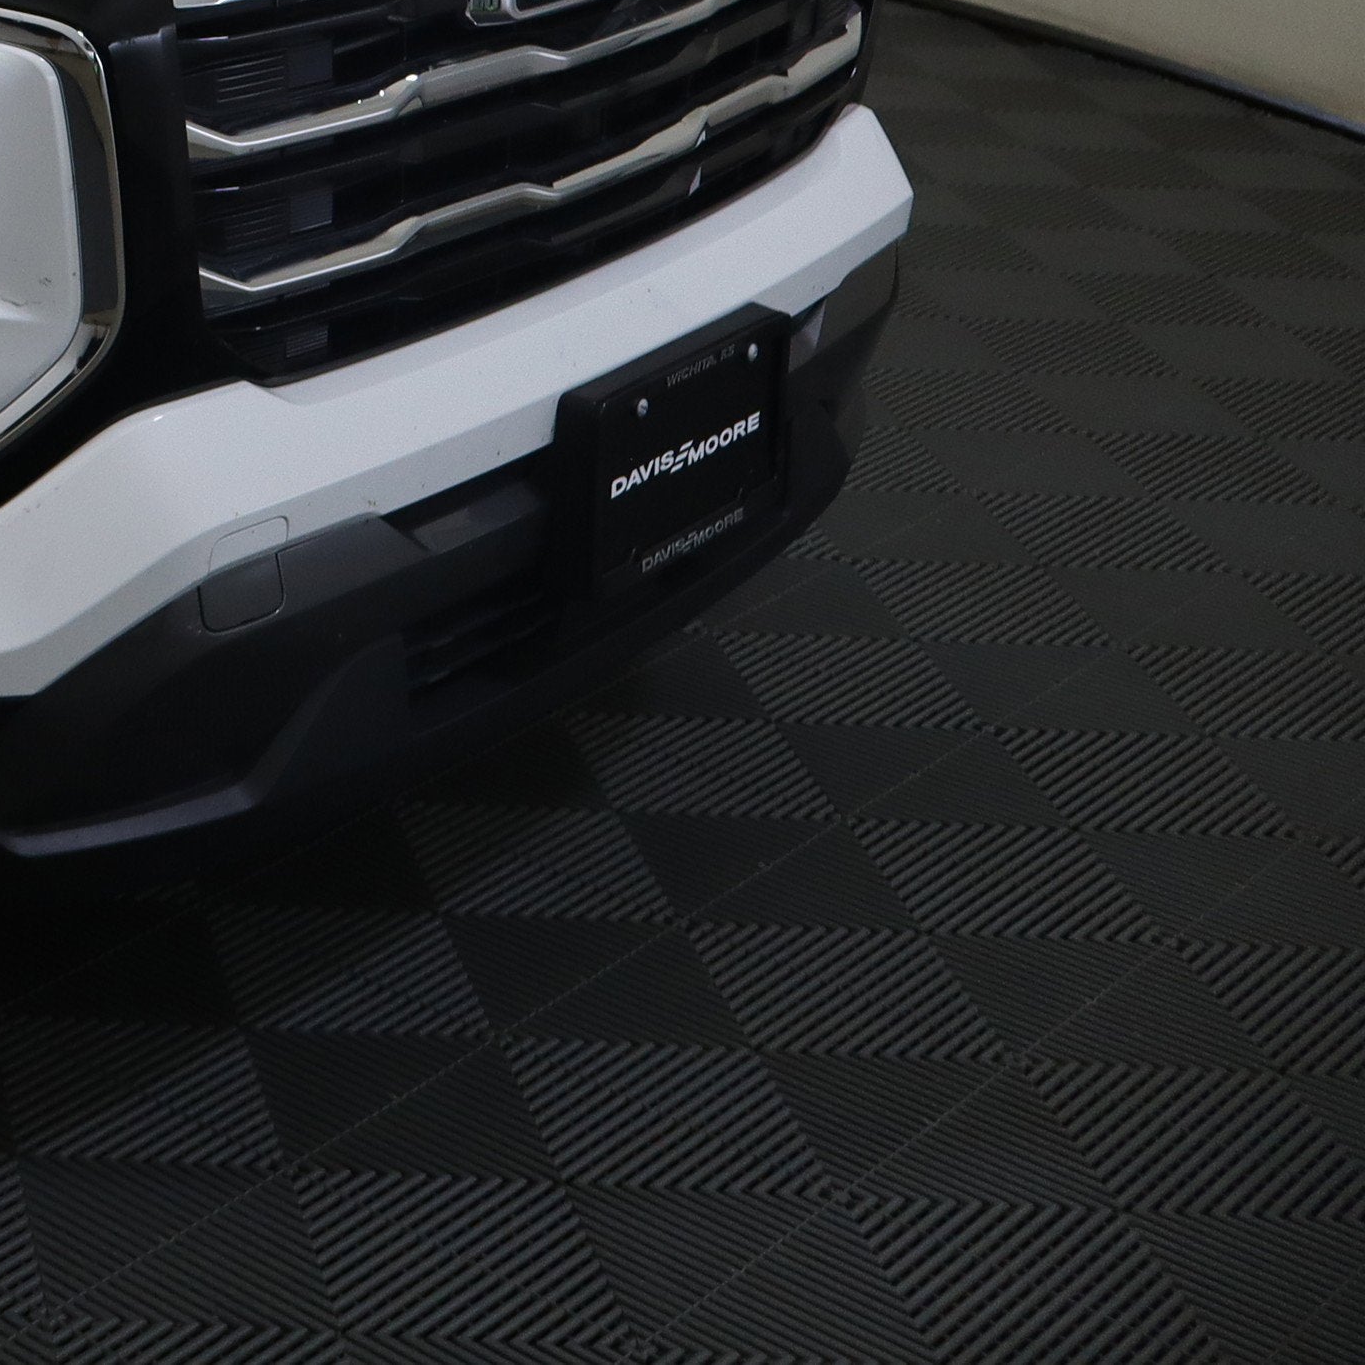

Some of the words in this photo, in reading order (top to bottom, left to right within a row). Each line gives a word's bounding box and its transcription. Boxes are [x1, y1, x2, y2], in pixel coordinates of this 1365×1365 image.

[610, 449, 674, 499] DAVIS
[687, 411, 761, 467] MOORE
[641, 536, 685, 573] DAVIS
[693, 506, 745, 547] MOORE
